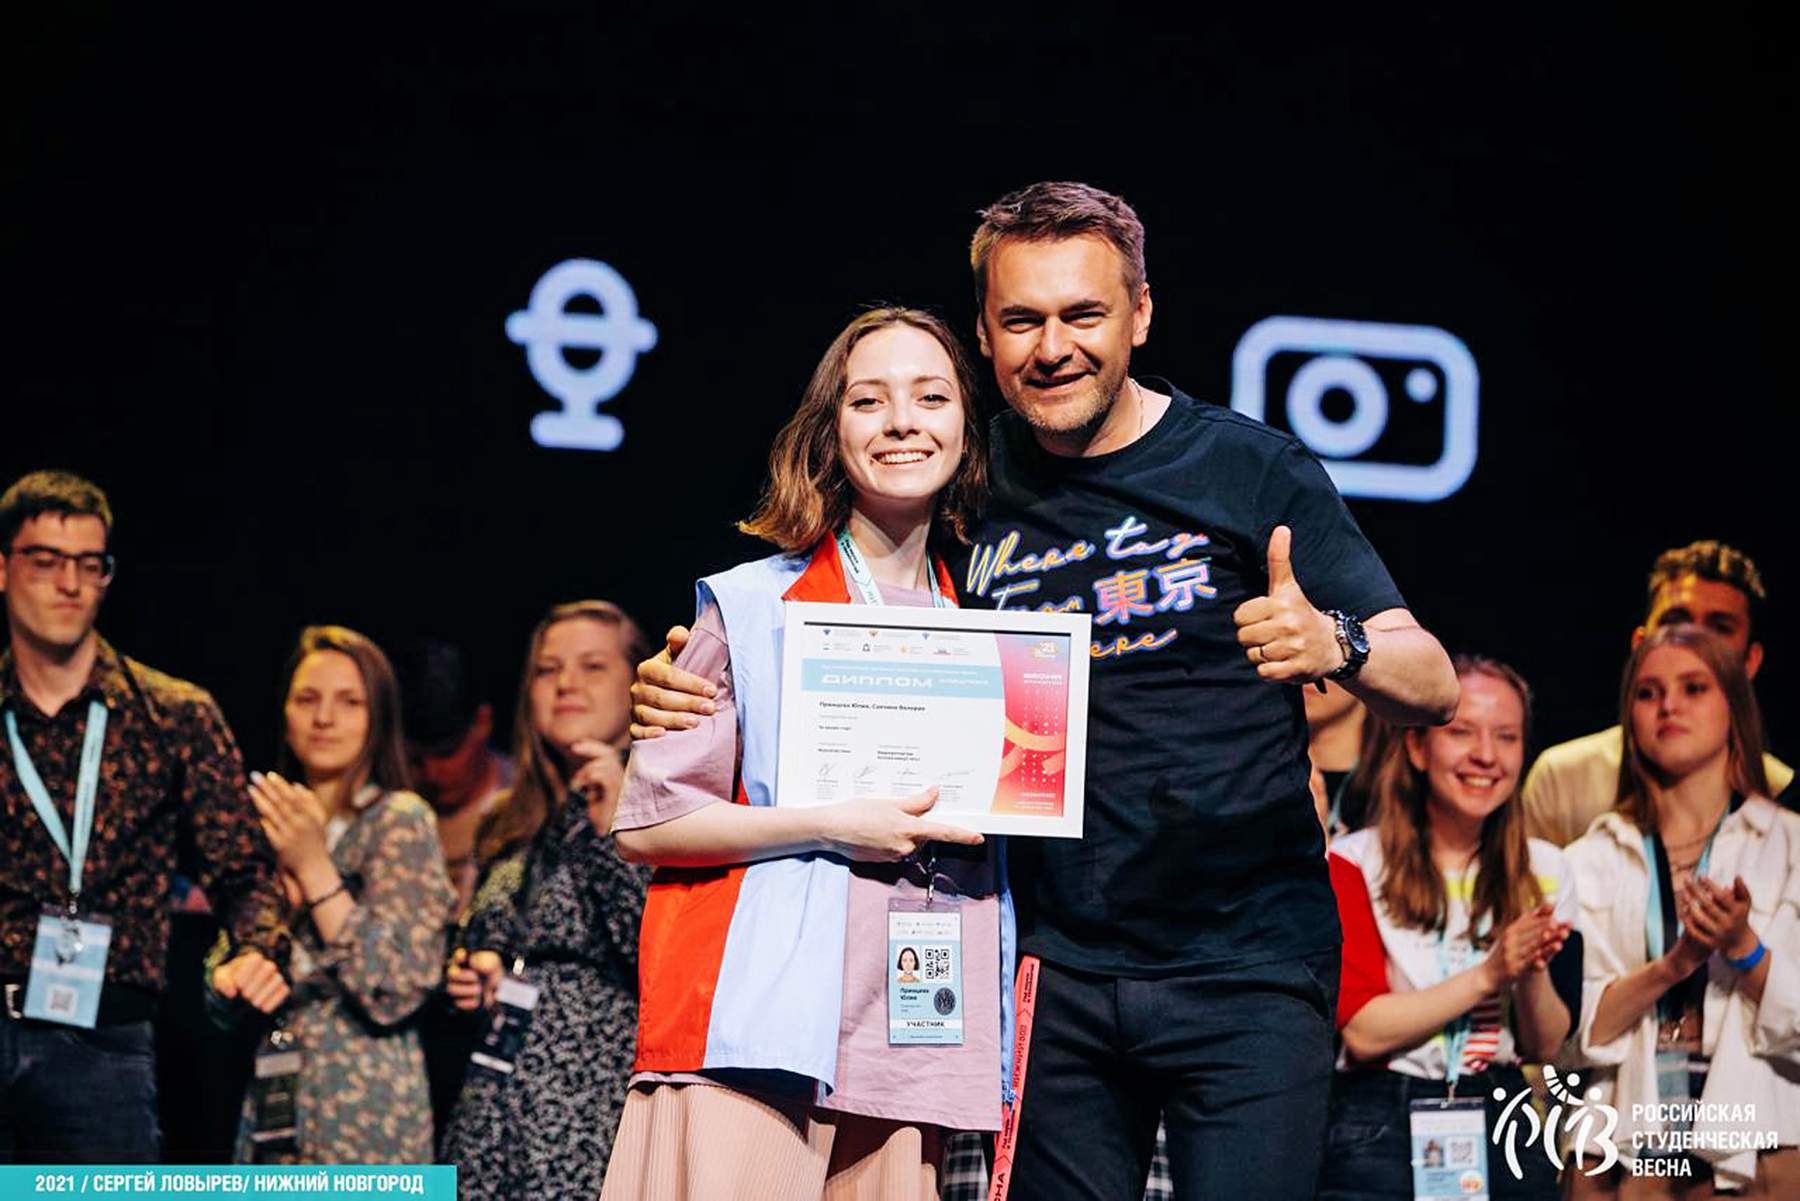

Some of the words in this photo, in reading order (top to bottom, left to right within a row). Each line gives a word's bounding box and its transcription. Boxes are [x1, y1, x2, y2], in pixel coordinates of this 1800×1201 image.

[966, 529, 1095, 597] Where
[1092, 556, 1219, 627] 東京
[821, 673, 933, 689] ДИПЛОМ
